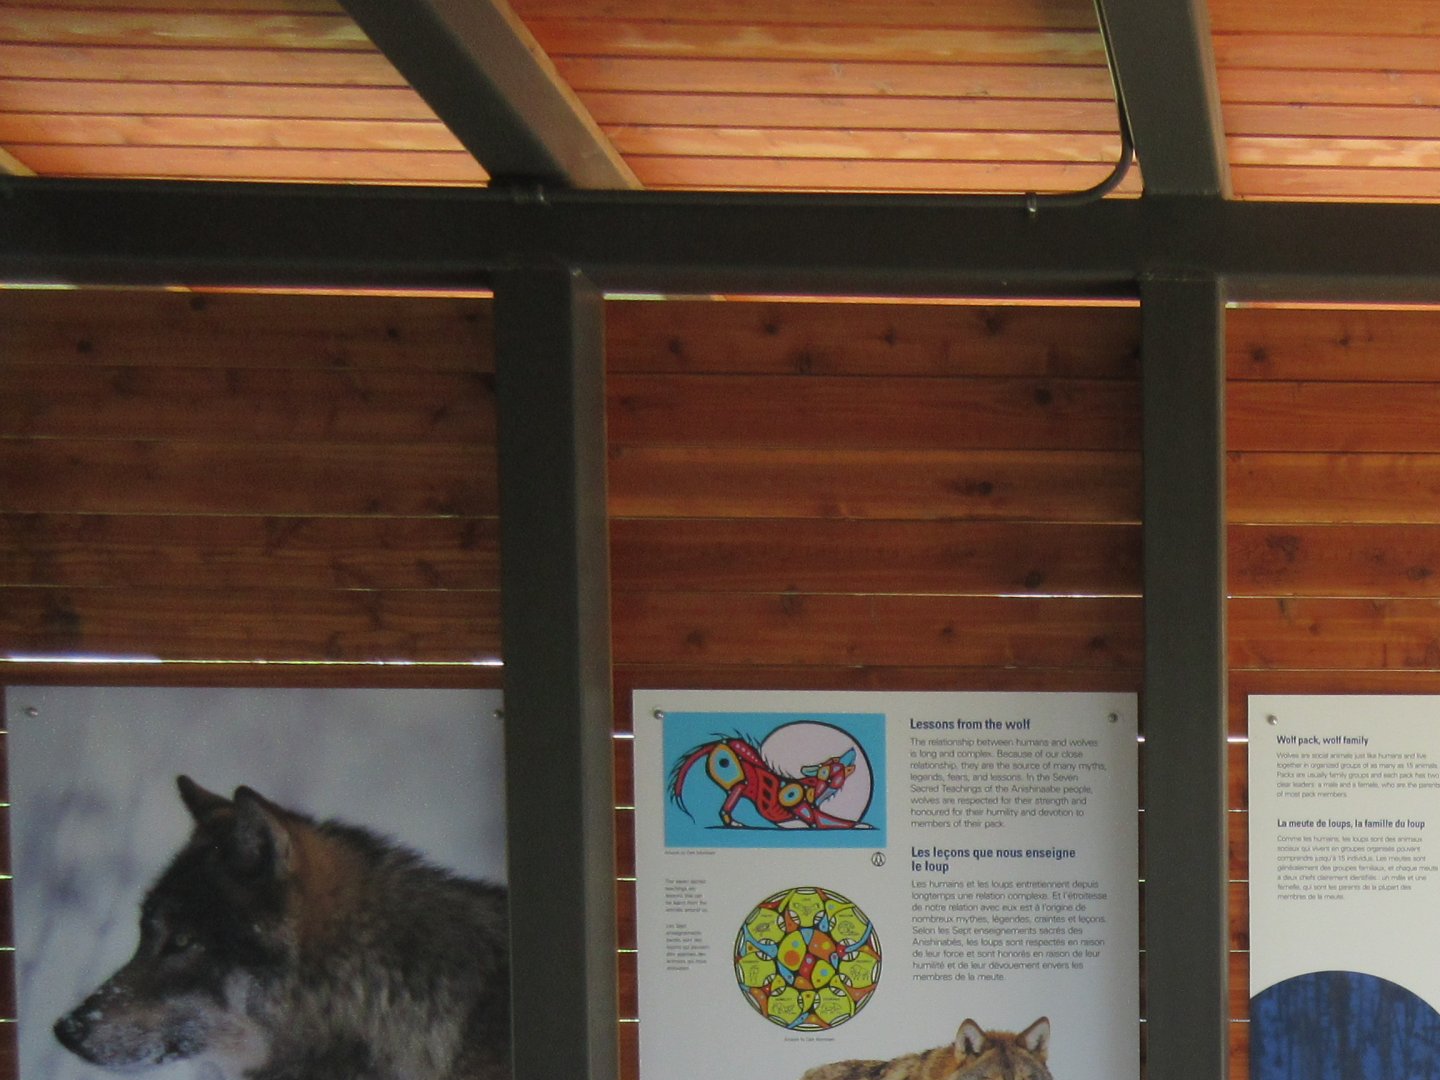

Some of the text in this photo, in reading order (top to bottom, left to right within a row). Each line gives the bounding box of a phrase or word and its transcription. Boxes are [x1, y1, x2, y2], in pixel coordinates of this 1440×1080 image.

[910, 718, 1030, 730] Lessons from the wolf
[1277, 736, 1296, 745] Wolf
[1323, 736, 1341, 745] wolf
[1343, 736, 1368, 746] family
[1278, 819, 1286, 828] La
[1289, 819, 1314, 828] meute
[1316, 819, 1326, 828] de
[1355, 819, 1362, 828] la
[1365, 819, 1393, 828] famille
[1395, 819, 1405, 828] du
[1408, 819, 1425, 830] loup
[912, 847, 1075, 861] Les leçons que nous enseigne
[912, 861, 948, 874] le loup
